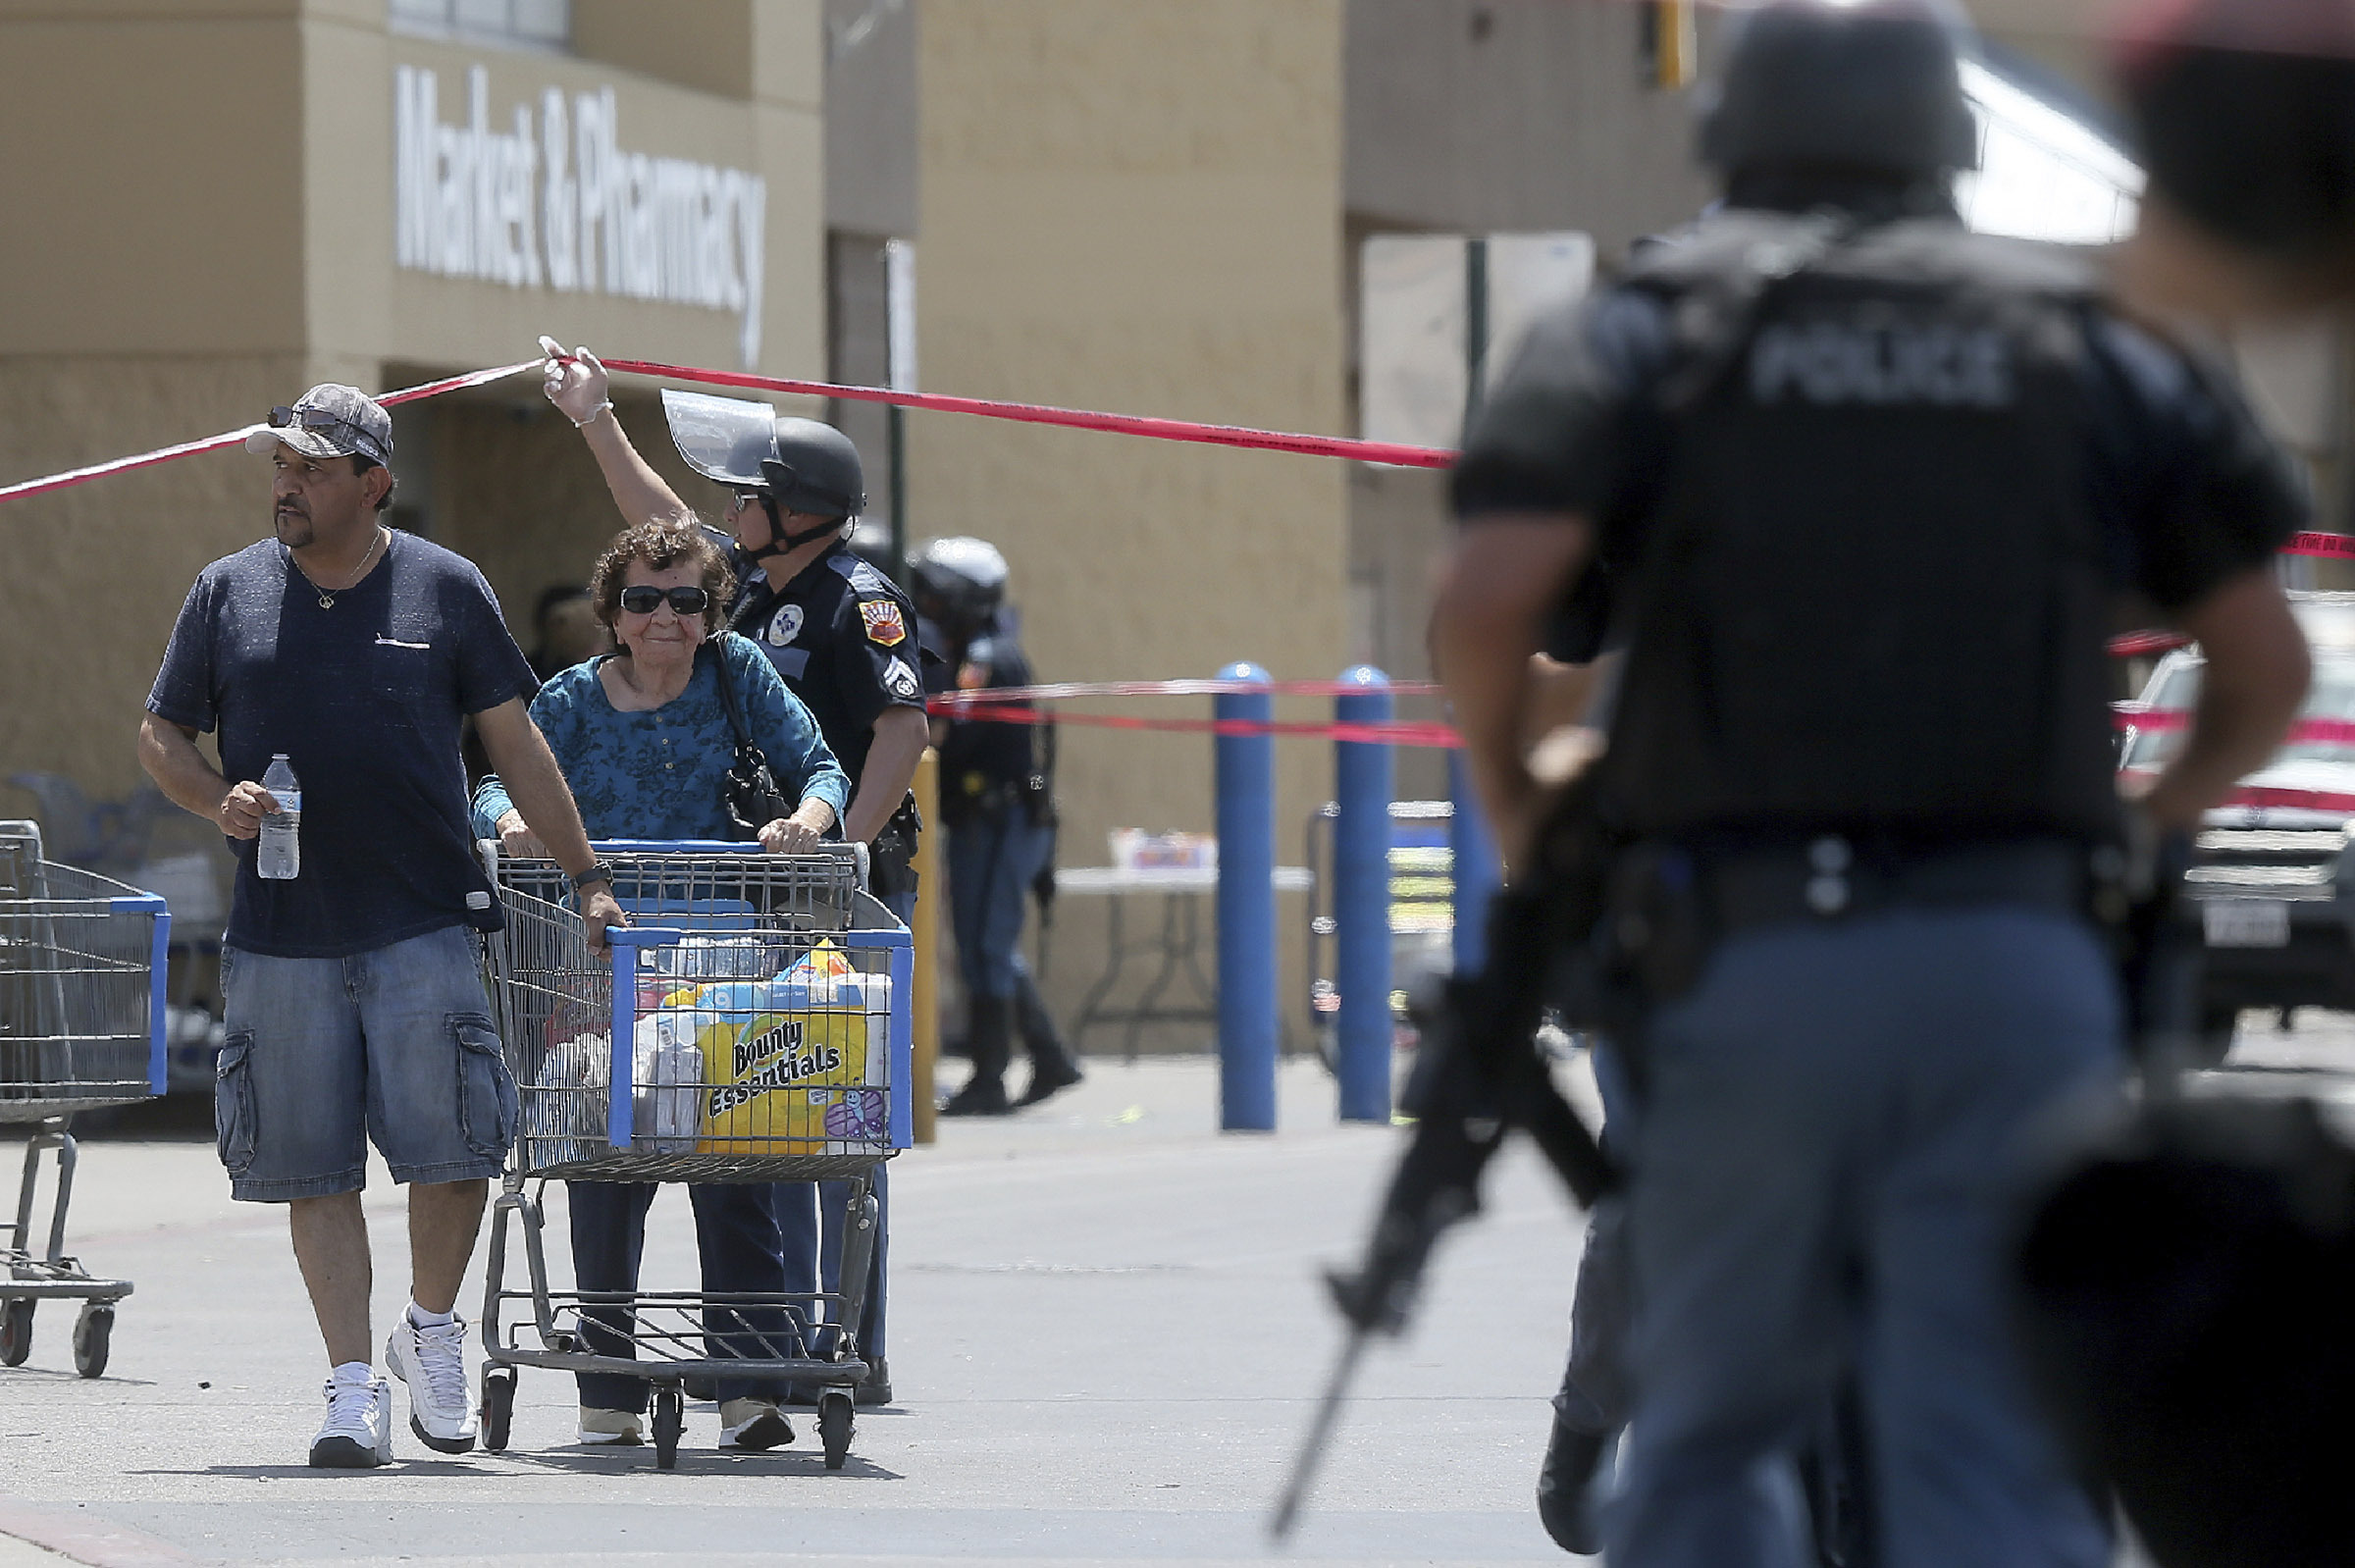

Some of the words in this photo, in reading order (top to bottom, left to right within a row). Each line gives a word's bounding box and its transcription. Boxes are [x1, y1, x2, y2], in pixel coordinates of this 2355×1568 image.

[397, 64, 542, 288] Market
[542, 87, 579, 291] &
[576, 84, 766, 370] Pharmacy
[1753, 325, 2015, 406] POLICE
[708, 1044, 840, 1118] Essentials
[734, 1020, 803, 1077] Bounty
